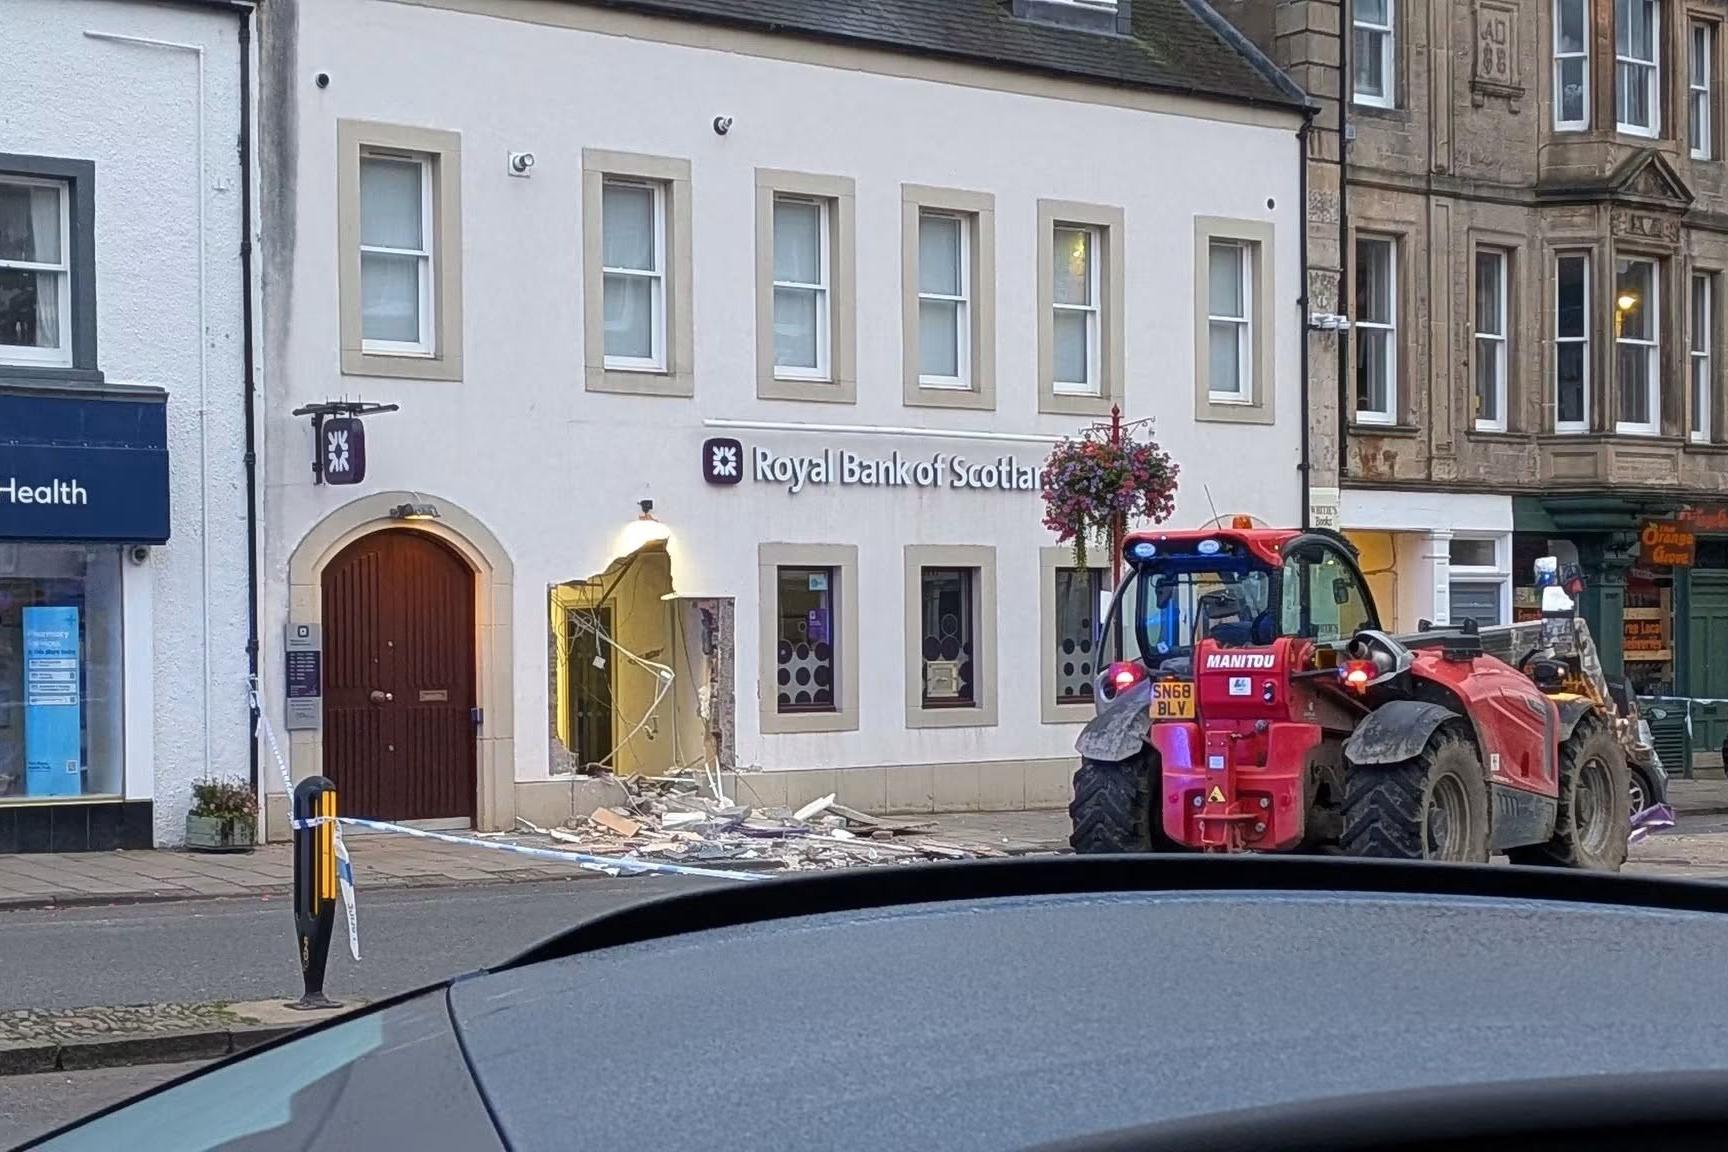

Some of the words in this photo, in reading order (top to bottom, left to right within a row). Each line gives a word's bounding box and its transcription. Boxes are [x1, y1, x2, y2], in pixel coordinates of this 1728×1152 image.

[753, 447, 834, 493] Royal
[840, 447, 913, 489] Bank
[914, 451, 946, 488] of
[949, 454, 1043, 490] Scotlan
[0, 477, 88, 505] Health
[1642, 527, 1694, 546] Orange
[1206, 654, 1275, 669] MANITOU
[1152, 684, 1191, 699] SN68
[1157, 700, 1187, 716] BLV
